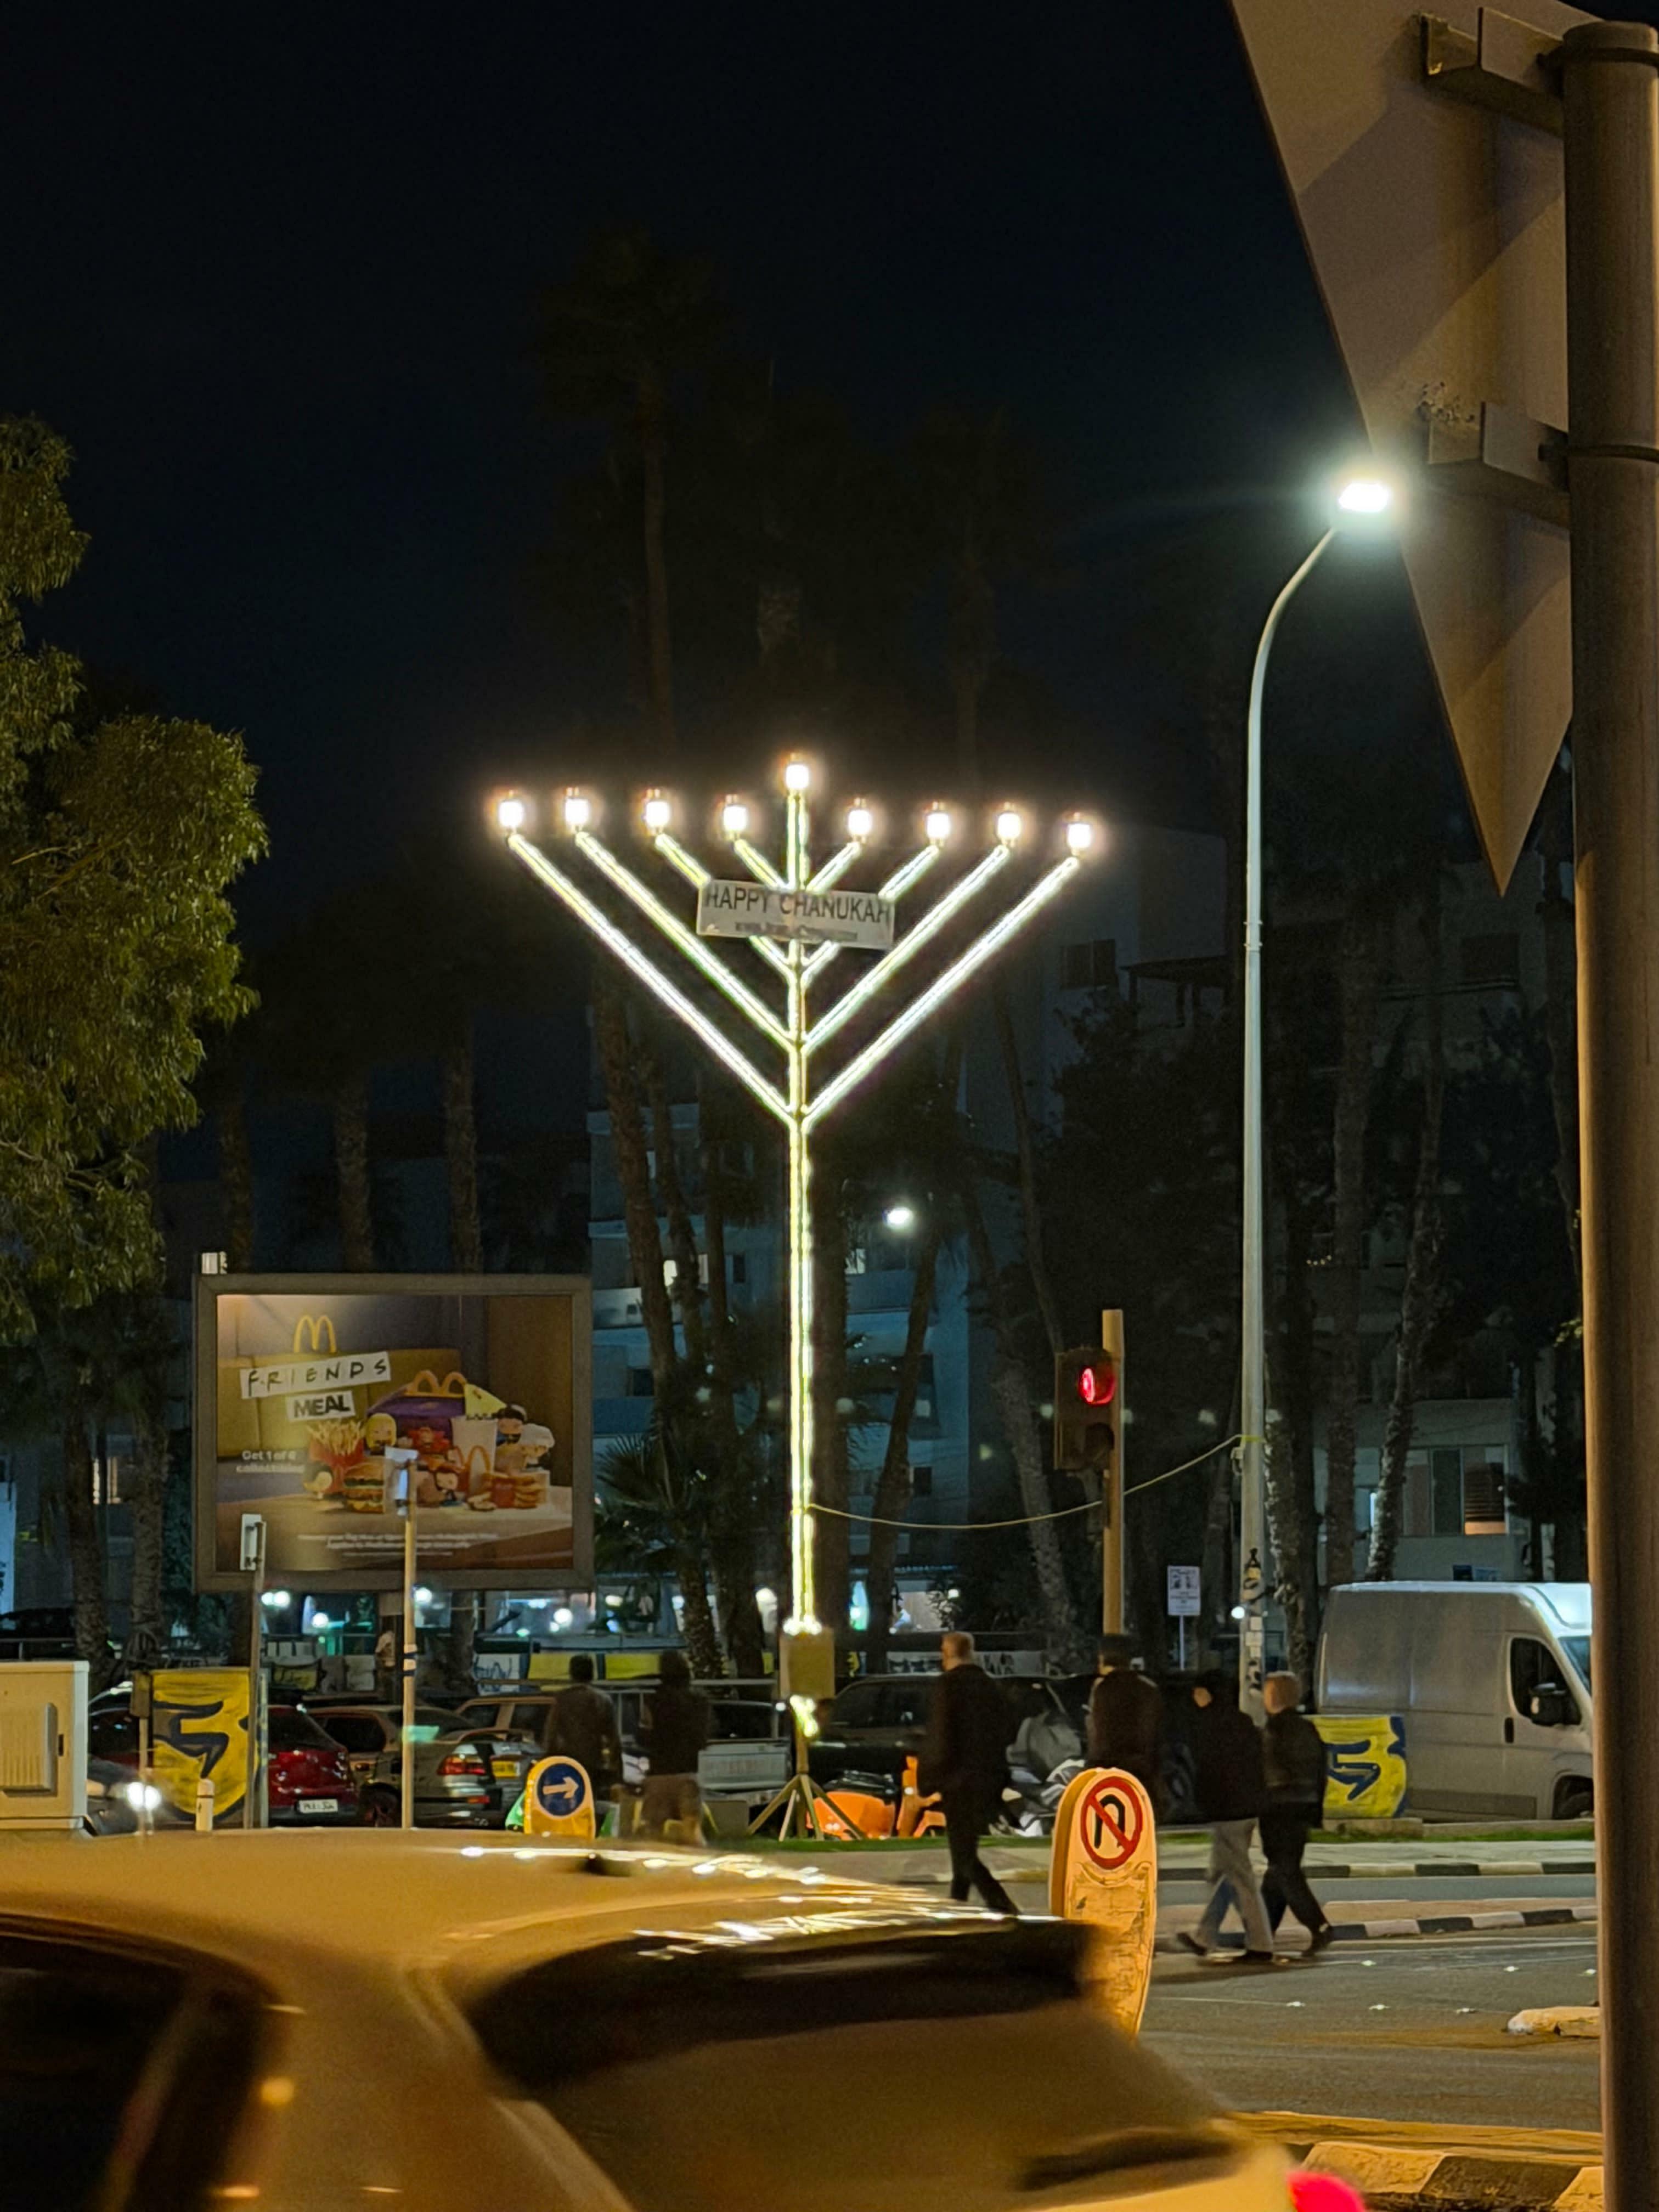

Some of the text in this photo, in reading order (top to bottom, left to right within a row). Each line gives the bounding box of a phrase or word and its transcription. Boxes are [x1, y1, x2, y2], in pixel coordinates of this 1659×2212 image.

[705, 883, 890, 924] HAPPY CHANUKAH
[294, 1395, 351, 1418] MEAL
